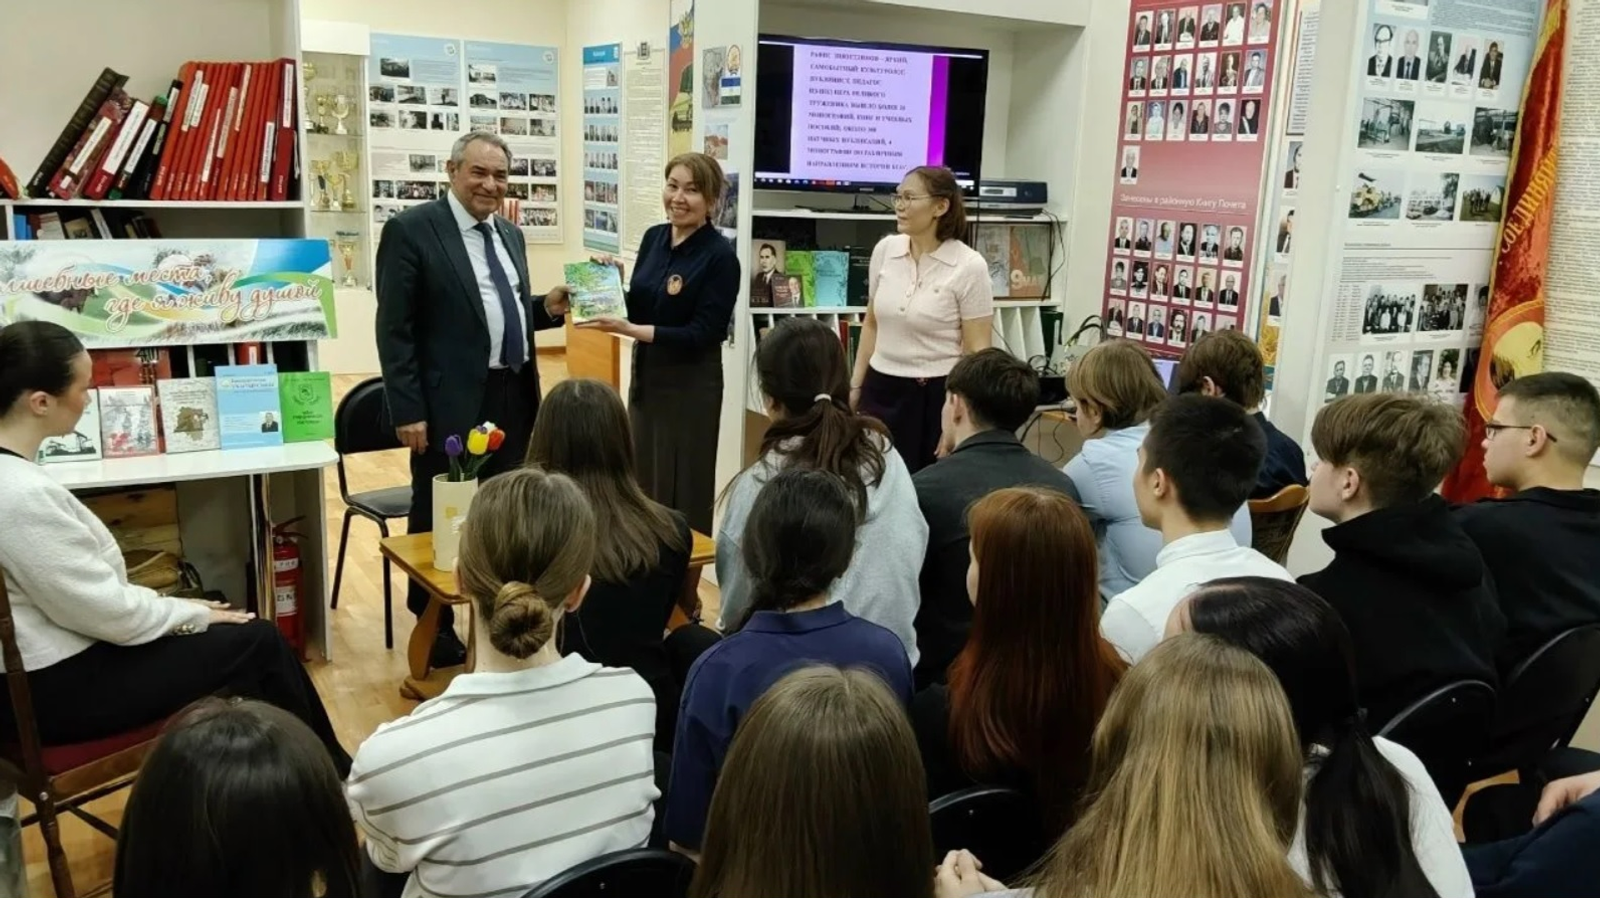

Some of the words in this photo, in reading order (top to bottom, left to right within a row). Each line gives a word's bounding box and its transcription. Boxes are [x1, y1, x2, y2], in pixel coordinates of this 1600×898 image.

[1120, 193, 1153, 204] Занесены
[1159, 196, 1195, 208] районную
[1196, 198, 1216, 209] Книгу
[1218, 199, 1247, 210] Почета
[126, 266, 212, 287] места,
[104, 297, 142, 332] где
[152, 296, 174, 311] я
[175, 271, 241, 322] живу
[239, 280, 322, 322] душой
